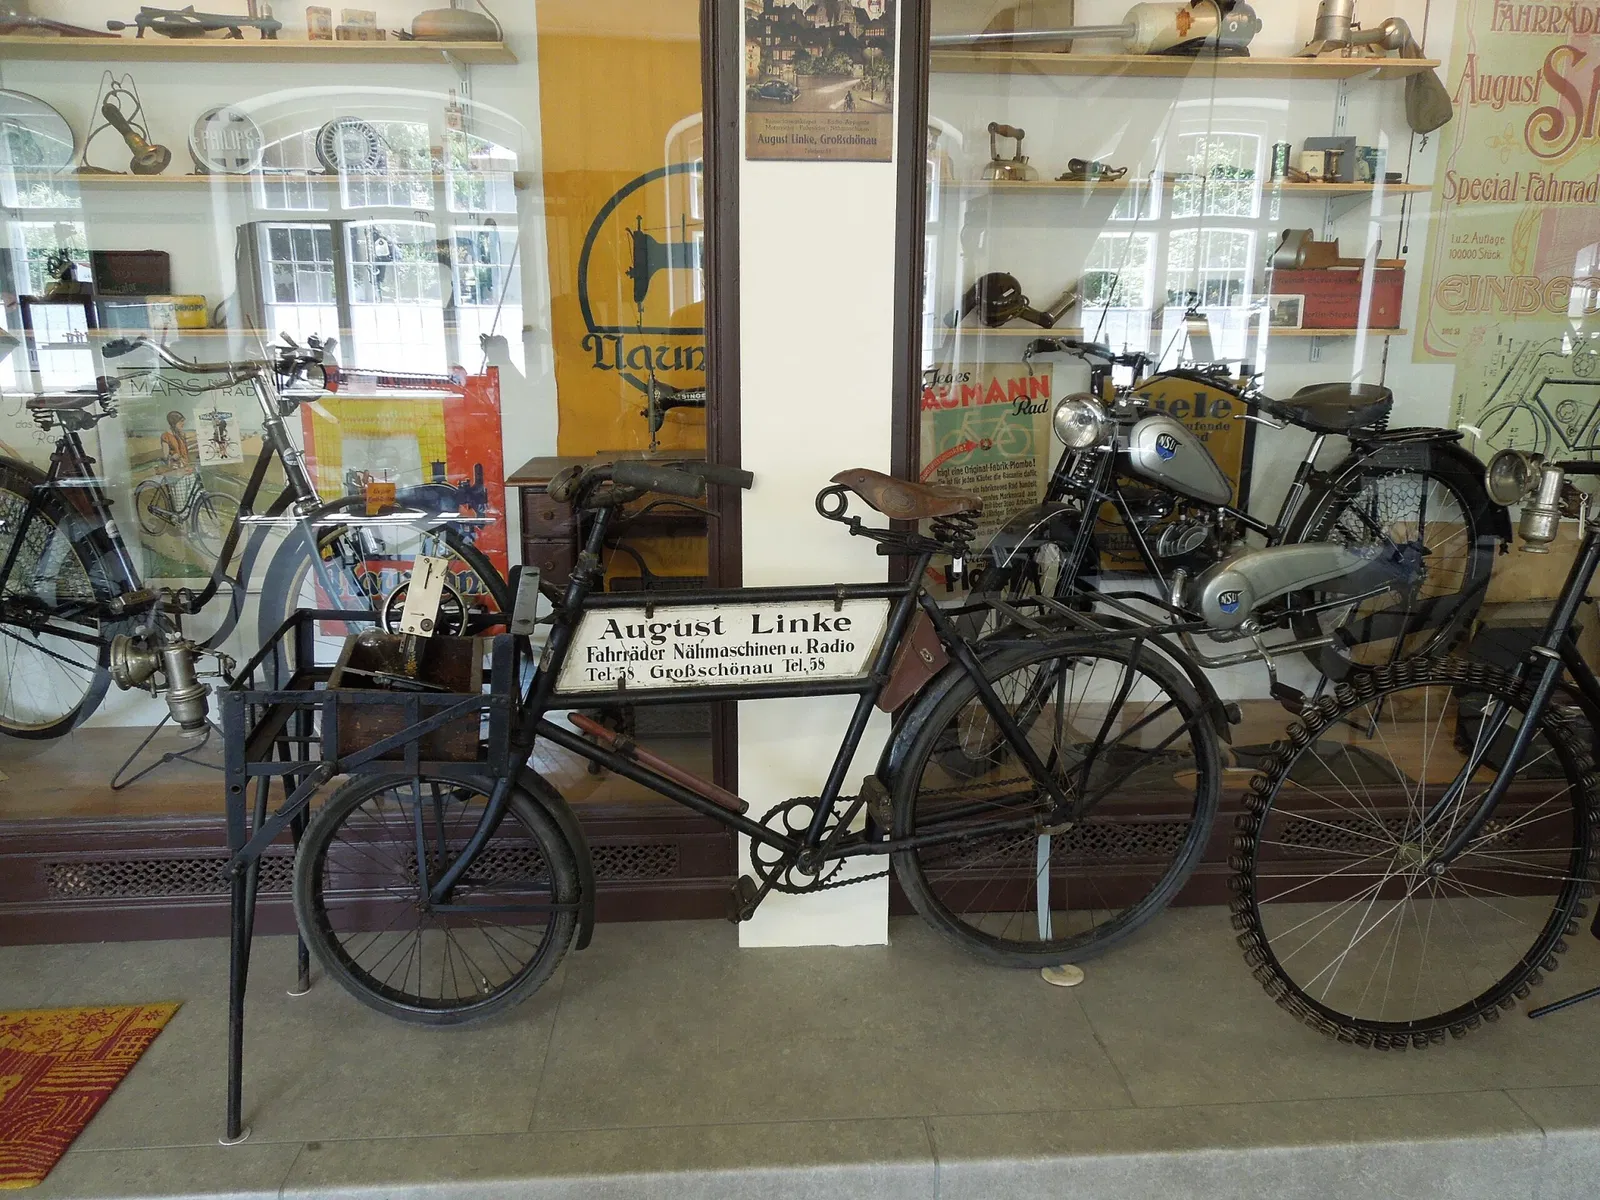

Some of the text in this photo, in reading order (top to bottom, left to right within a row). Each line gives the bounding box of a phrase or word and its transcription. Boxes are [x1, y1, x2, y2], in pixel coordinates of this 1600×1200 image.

[1452, 53, 1543, 110] August
[203, 128, 255, 151] PHILIPS
[757, 133, 877, 145] August Linke, Großschönau
[129, 377, 201, 397] MARS
[922, 369, 971, 391] Jedes
[222, 386, 257, 397] RAD
[921, 375, 1050, 411] AUMANN
[1012, 395, 1049, 416] Rad
[1158, 434, 1177, 451] NSU
[951, 468, 964, 476] eine
[1220, 593, 1239, 605] NSU
[598, 612, 852, 645] August Linke
[586, 638, 855, 663] Fahrräder Nähmaschinen u. Radio
[650, 662, 774, 679] Großschönau
